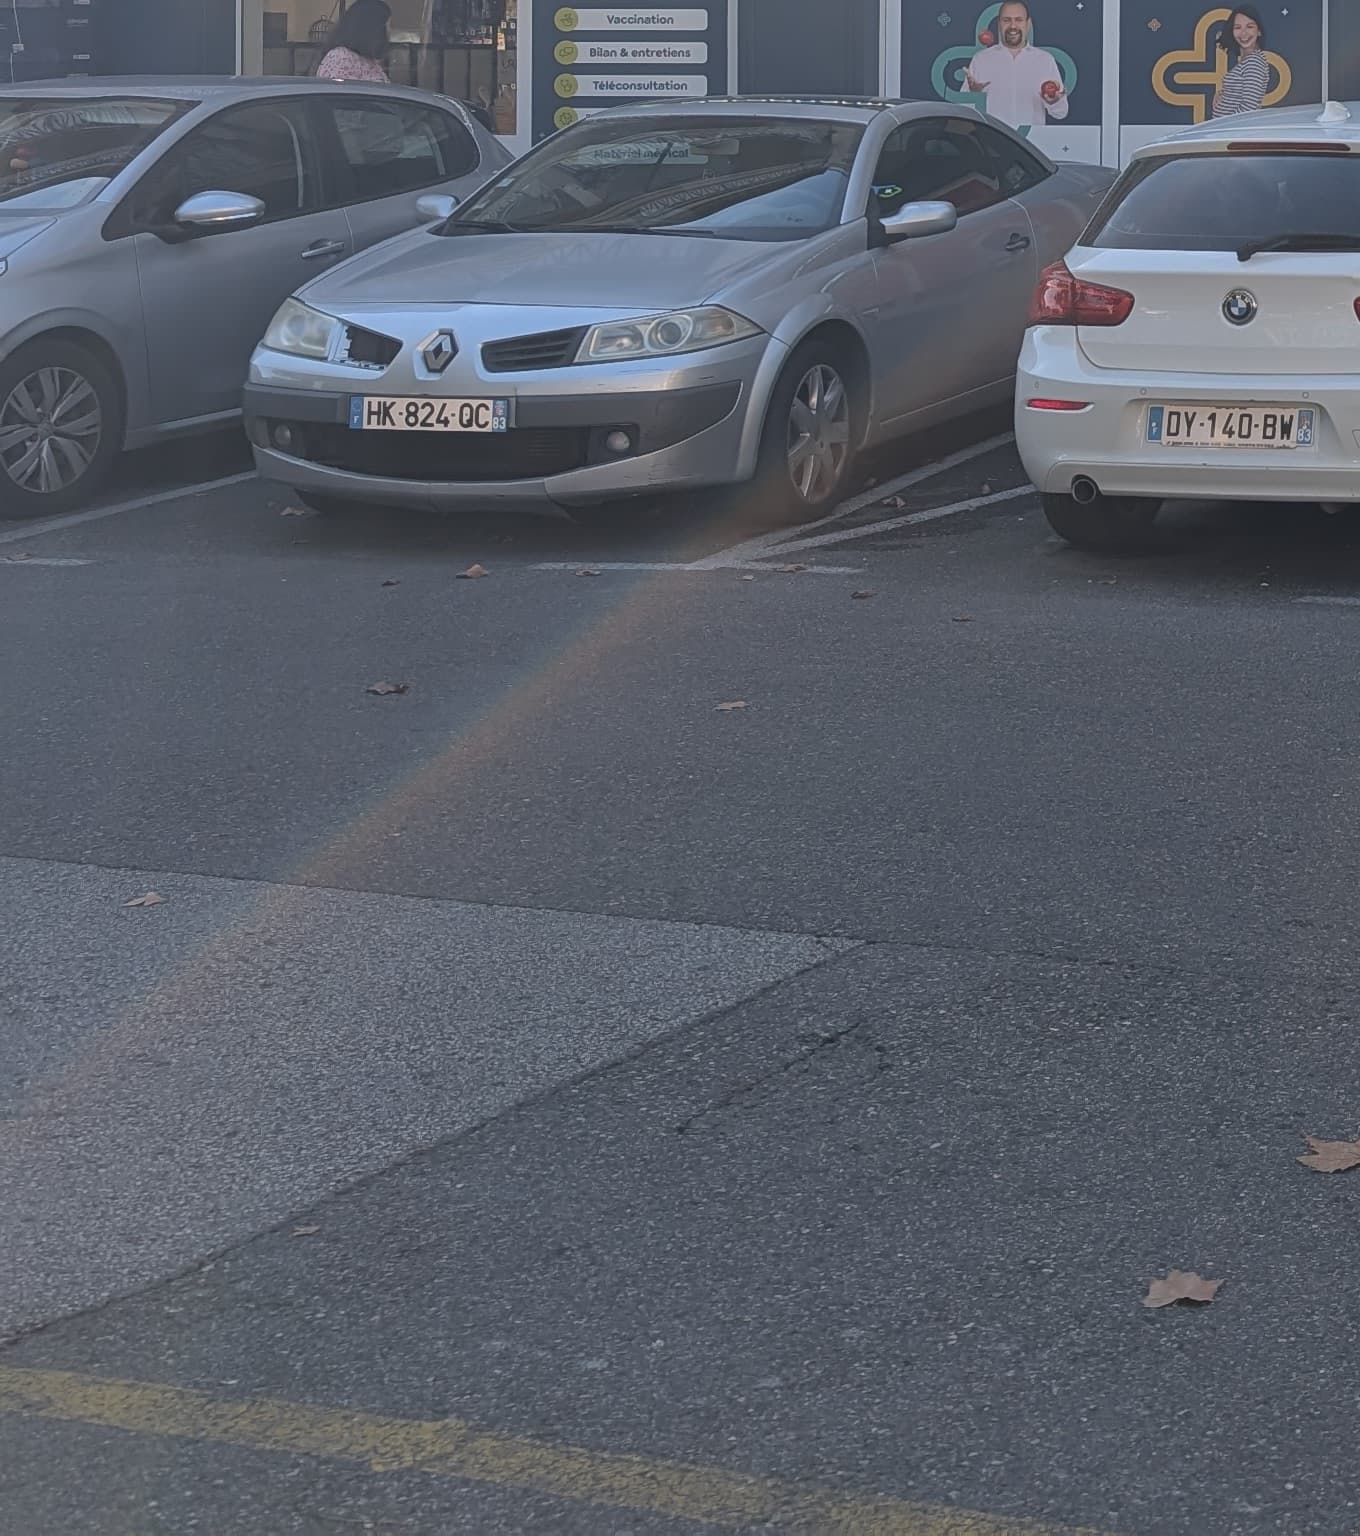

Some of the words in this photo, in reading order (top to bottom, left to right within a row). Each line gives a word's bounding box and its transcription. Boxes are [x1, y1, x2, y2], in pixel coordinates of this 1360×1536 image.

[606, 14, 674, 25] Vaccination
[589, 47, 617, 58] Bilan
[620, 48, 628, 58] &
[632, 48, 691, 58] entretiens
[592, 80, 688, 91] Téléconsultation
[353, 416, 360, 424] F
[367, 401, 490, 429] HK-824-QC
[492, 417, 506, 430] 83
[1166, 411, 1294, 441] DY-140-BW
[1297, 429, 1311, 442] 83
